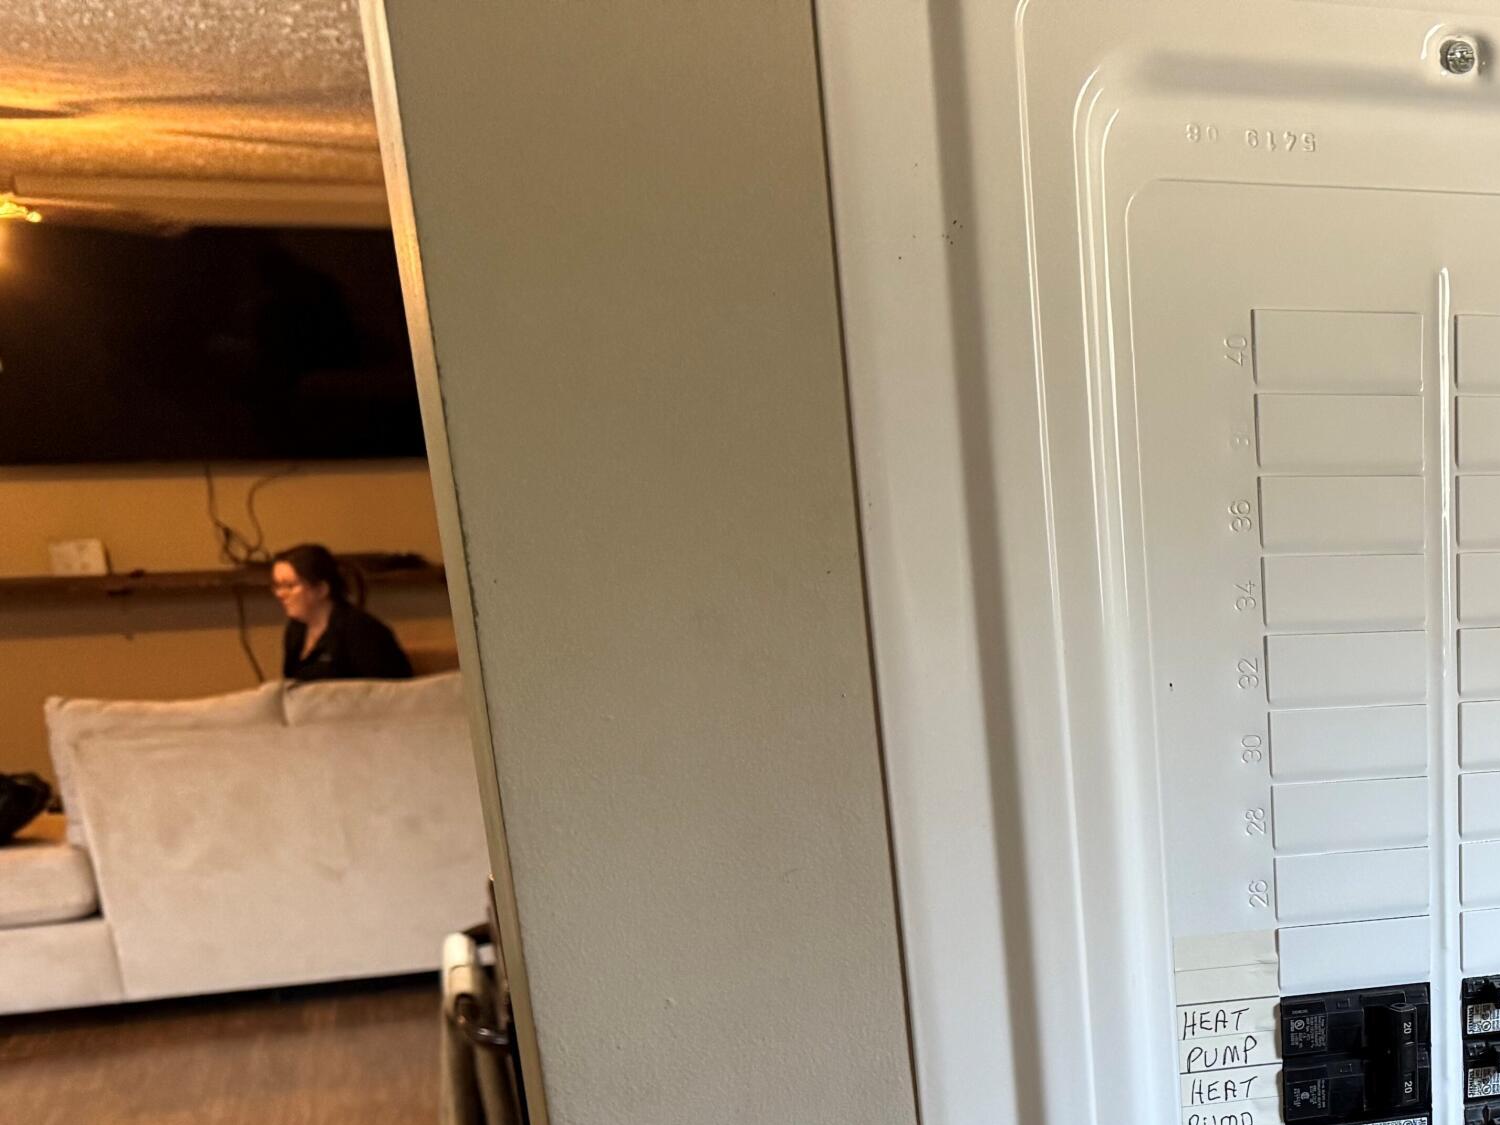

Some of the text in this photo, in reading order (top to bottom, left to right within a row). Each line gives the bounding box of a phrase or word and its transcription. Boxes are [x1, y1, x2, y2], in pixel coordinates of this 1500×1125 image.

[1223, 334, 1248, 367] 40
[1233, 579, 1256, 612] 34
[1236, 657, 1259, 690] 32
[1240, 734, 1262, 765] 30
[1244, 807, 1267, 837] 28
[1248, 879, 1269, 909] 26
[1183, 1007, 1250, 1040] HEAT
[1403, 1021, 1412, 1035] 20
[1187, 1035, 1257, 1072] PUMP
[1191, 1076, 1258, 1104] HEAT
[1404, 1080, 1413, 1094] 20
